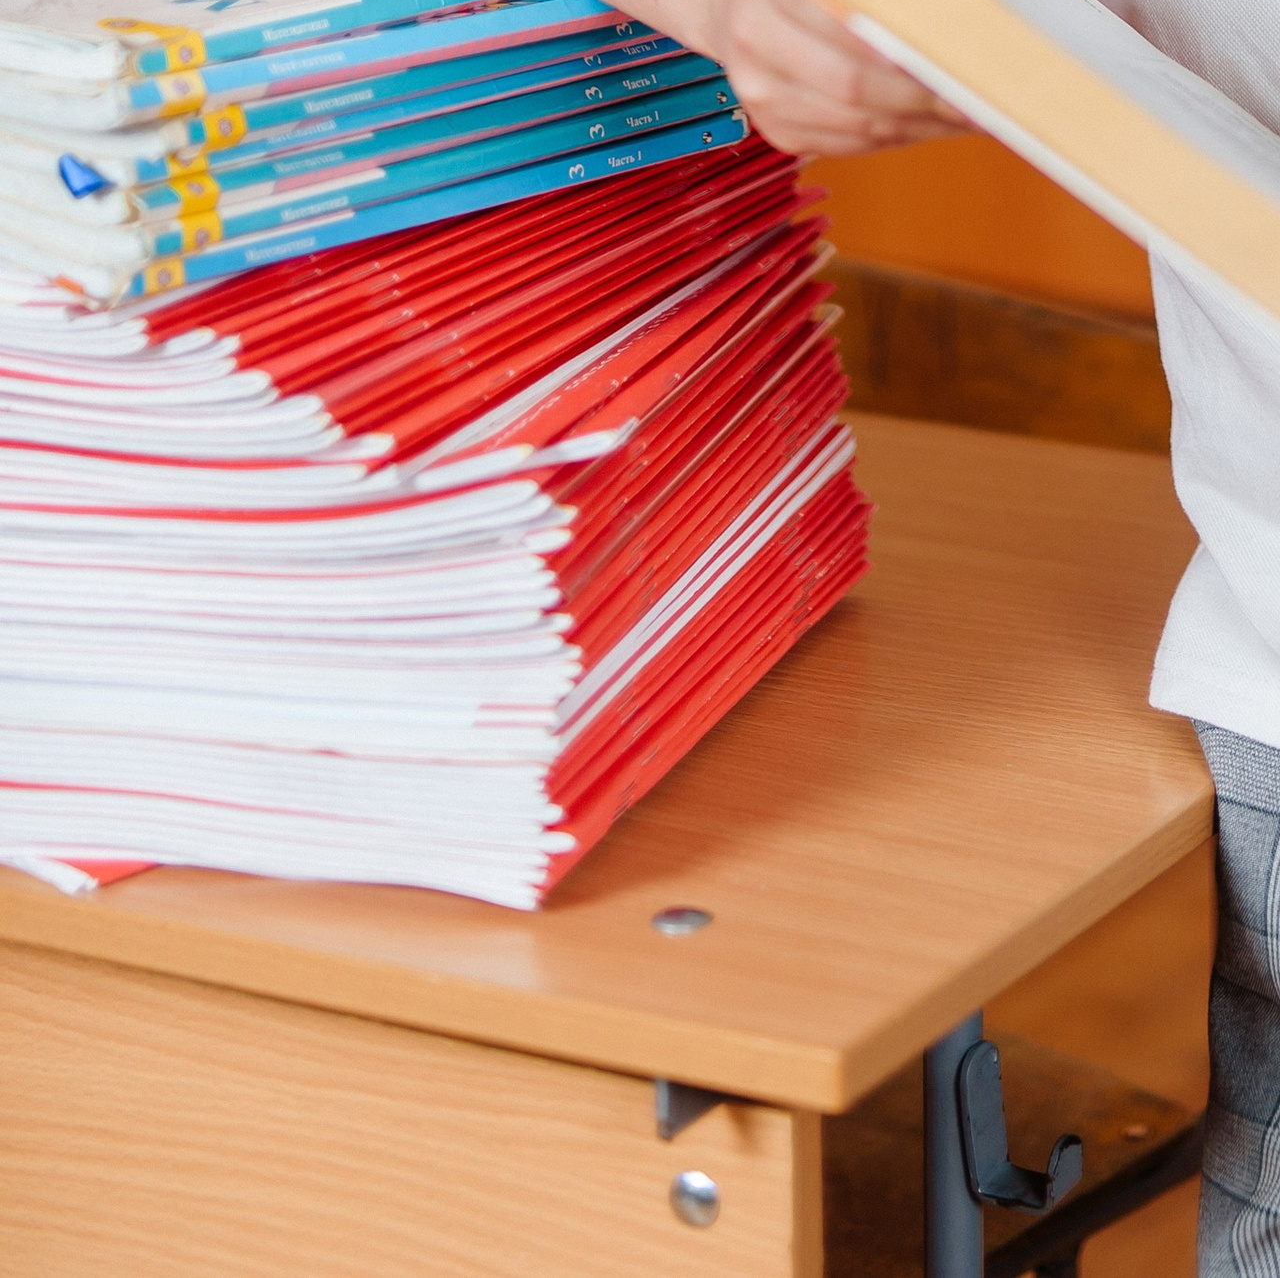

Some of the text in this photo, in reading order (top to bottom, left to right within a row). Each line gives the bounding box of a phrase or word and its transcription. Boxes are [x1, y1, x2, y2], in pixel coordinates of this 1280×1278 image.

[616, 22, 633, 37] 3
[585, 86, 603, 100] 3
[622, 77, 651, 90] Часть
[589, 123, 605, 139] 3
[626, 114, 653, 128] Часть
[568, 163, 585, 179] 3
[608, 154, 635, 168] Часть
